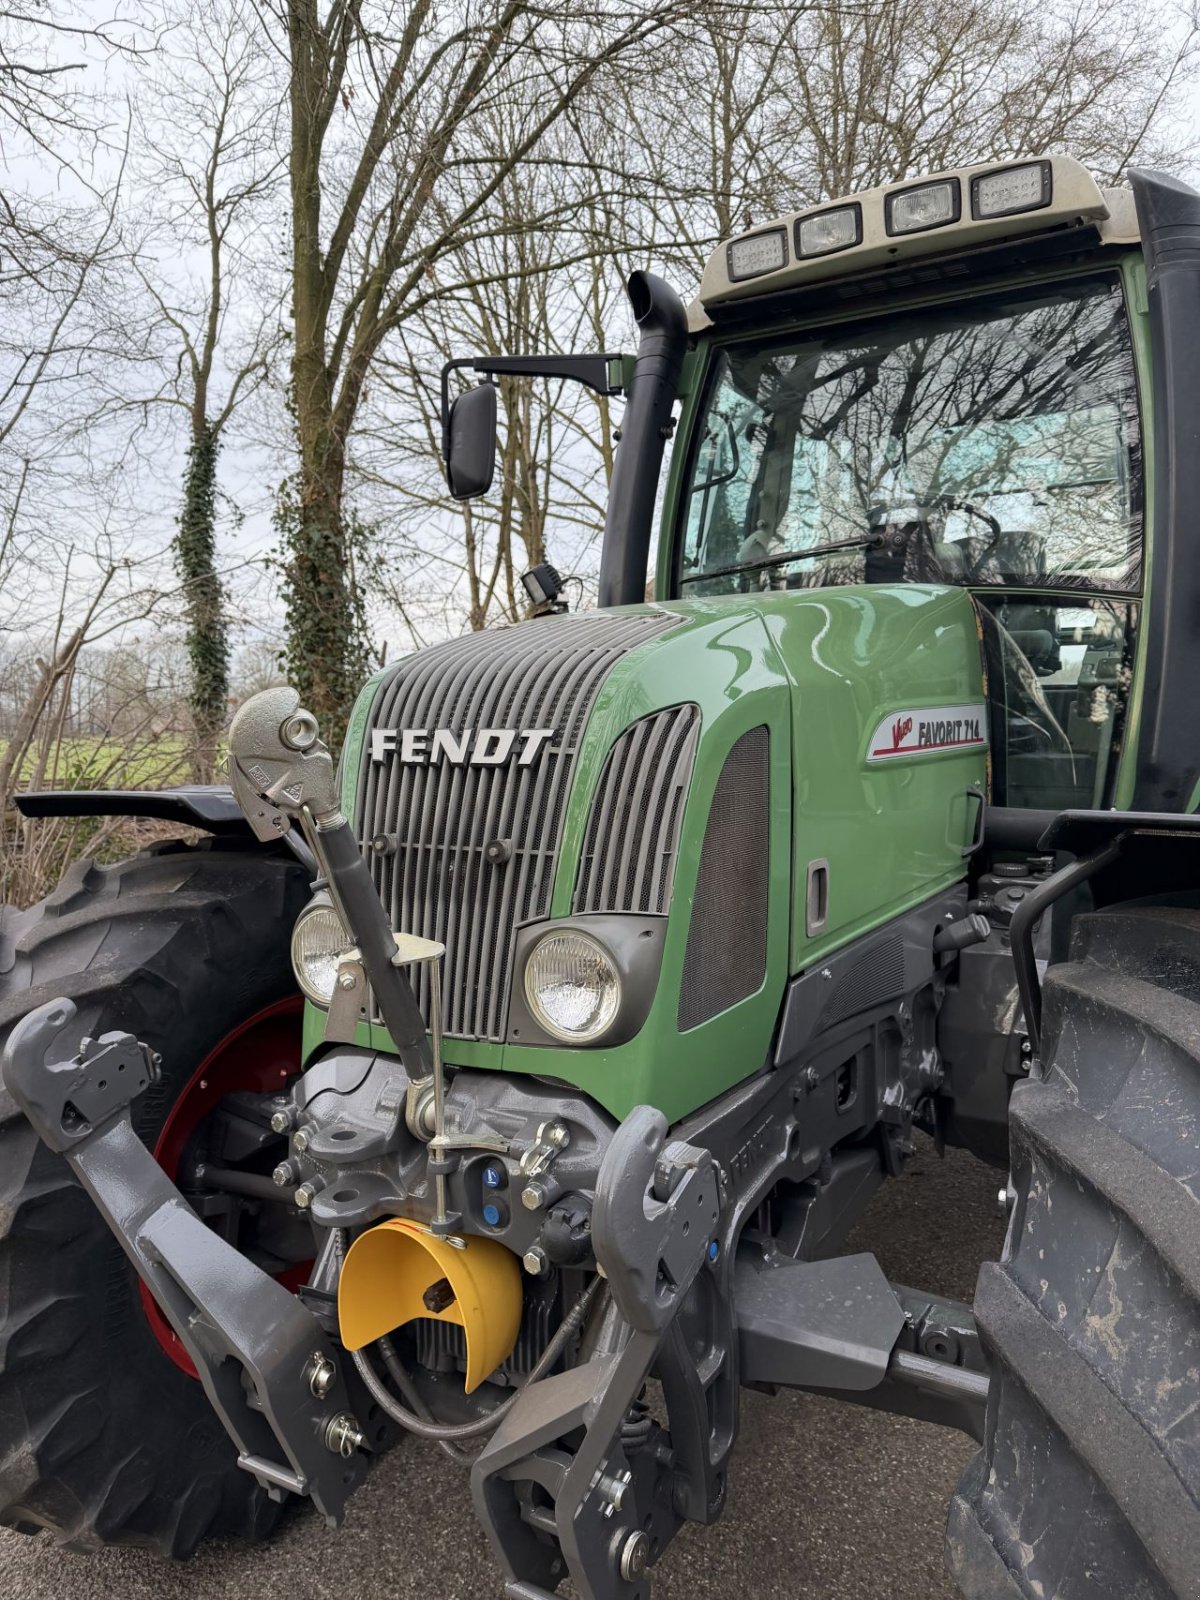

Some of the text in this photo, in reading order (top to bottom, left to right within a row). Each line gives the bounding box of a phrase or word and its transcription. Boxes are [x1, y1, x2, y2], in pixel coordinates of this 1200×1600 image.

[371, 728, 554, 767] FENDT
[919, 719, 962, 746] FAVORIT
[964, 719, 980, 740] 714
